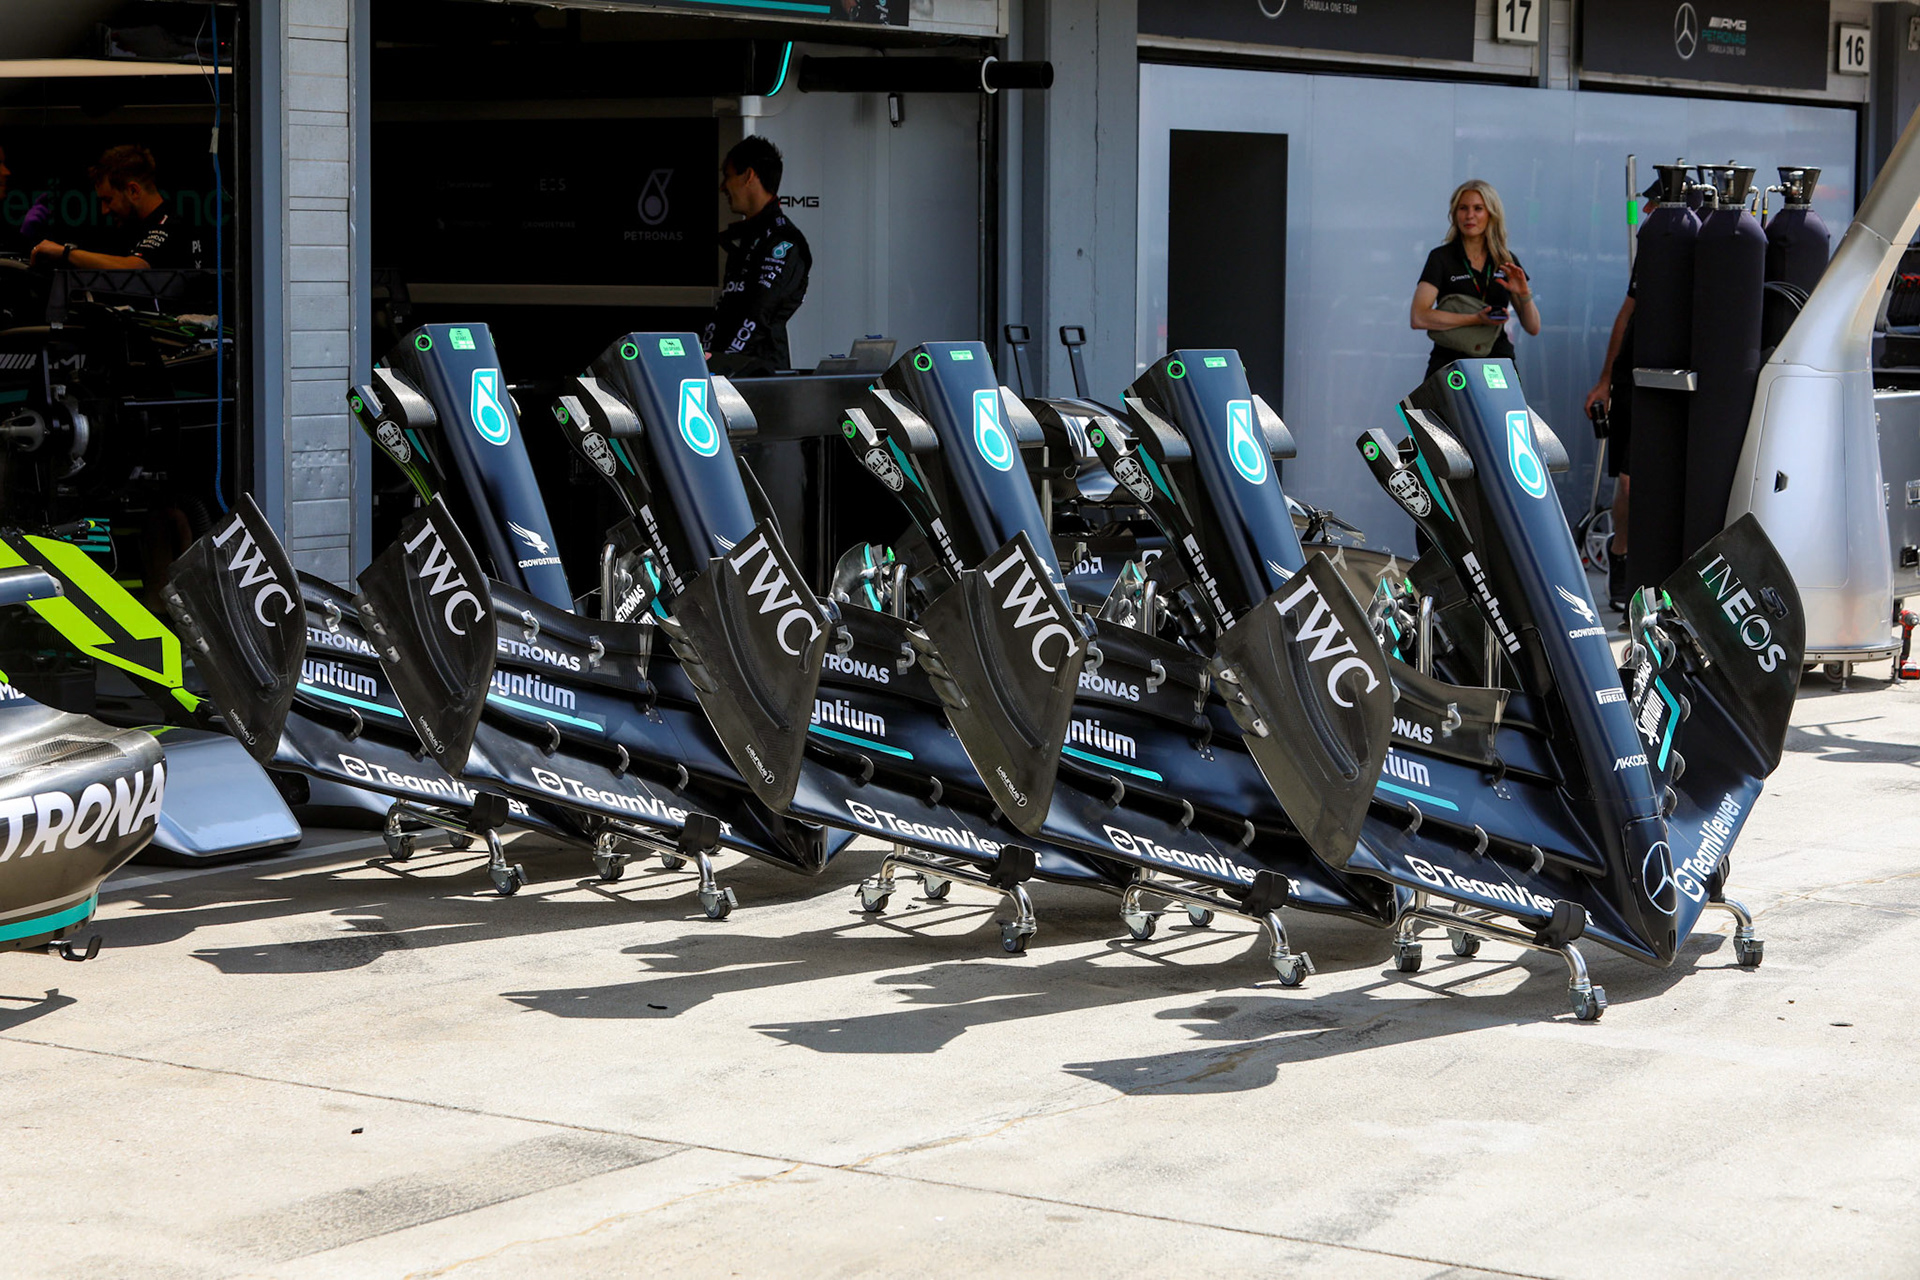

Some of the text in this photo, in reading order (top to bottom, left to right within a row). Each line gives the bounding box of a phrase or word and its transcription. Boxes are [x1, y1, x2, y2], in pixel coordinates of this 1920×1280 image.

[1303, 2, 1357, 14] FORMULA ONE TEAM
[1505, 0, 1531, 34] 17
[1702, 30, 1747, 46] PETRONAS
[1721, 18, 1747, 31] AMG
[1846, 35, 1864, 66] 16
[623, 230, 683, 242] PETRONAS
[211, 512, 297, 628] IWC
[403, 517, 487, 636] IWC
[728, 532, 823, 656] IWC
[983, 544, 1080, 673] IWC
[1697, 552, 1787, 673] INEOS
[1273, 574, 1380, 708] IWC
[1682, 792, 1742, 882] TeamViewer
